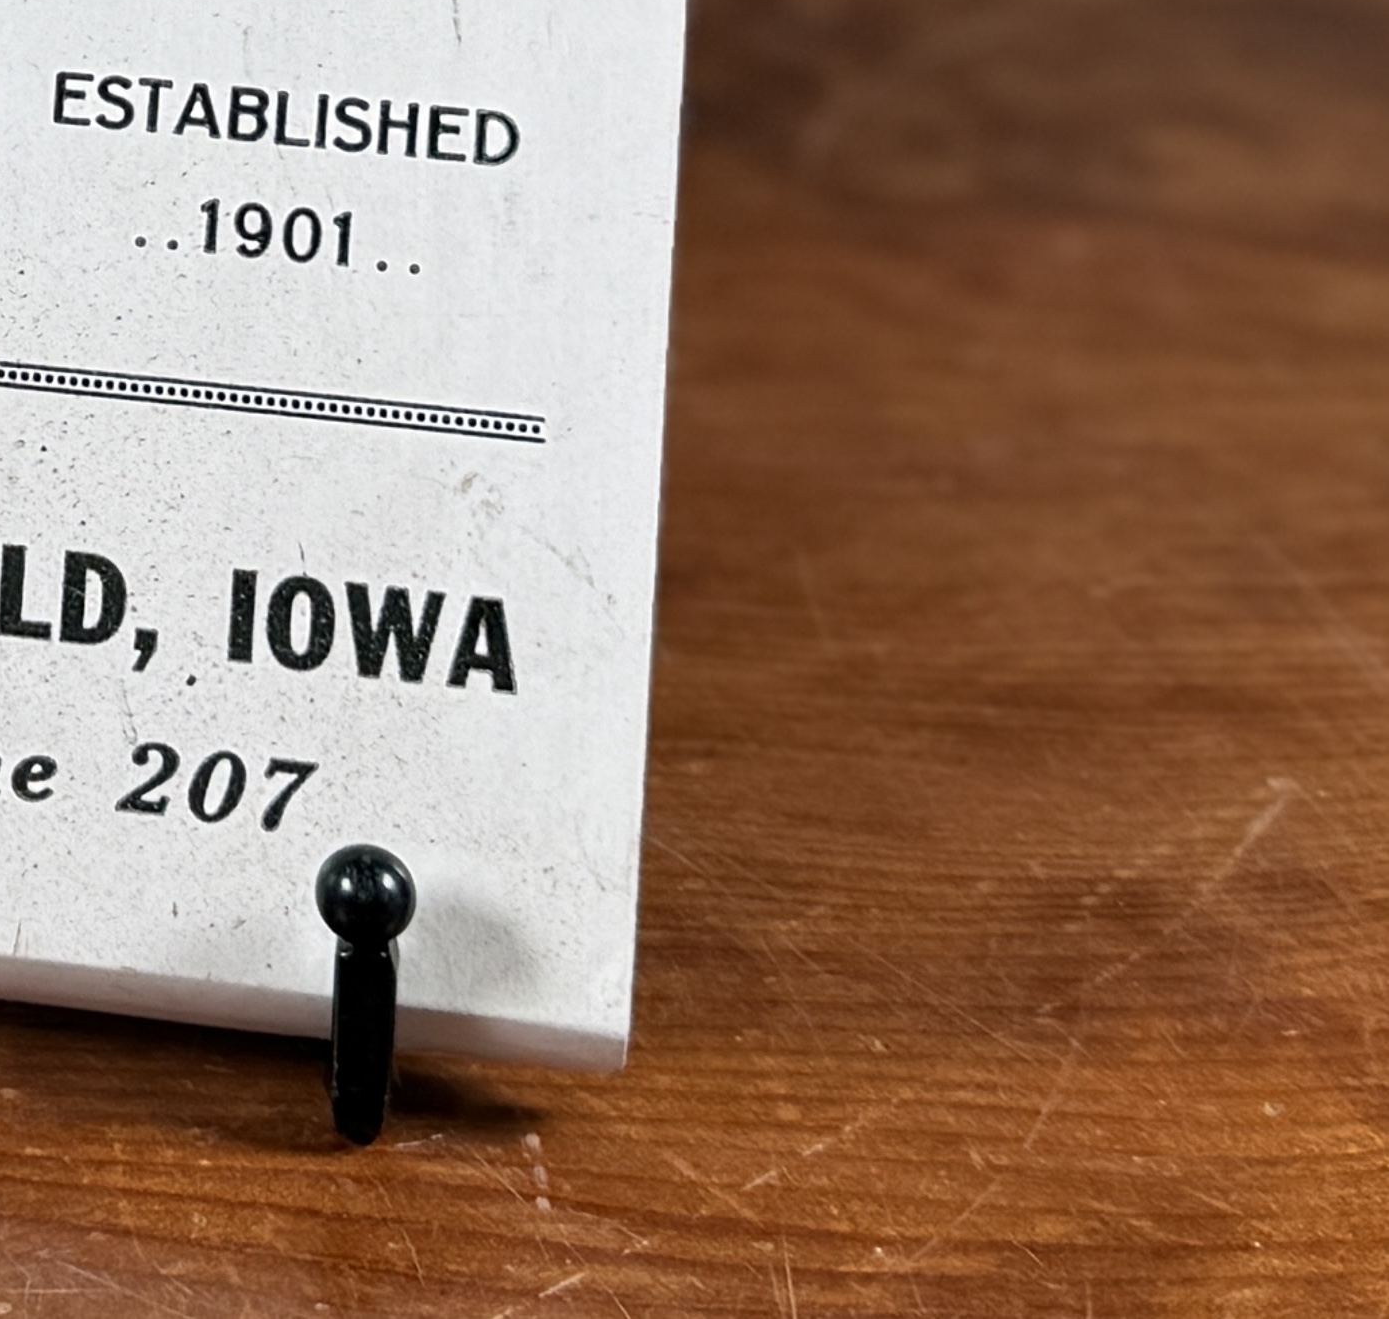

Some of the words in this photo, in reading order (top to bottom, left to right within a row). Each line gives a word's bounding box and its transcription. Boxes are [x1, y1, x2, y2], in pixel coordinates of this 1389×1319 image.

[52, 70, 521, 166] ESTABLISHED
[226, 567, 518, 696] IOWA
[113, 741, 320, 833] 207
